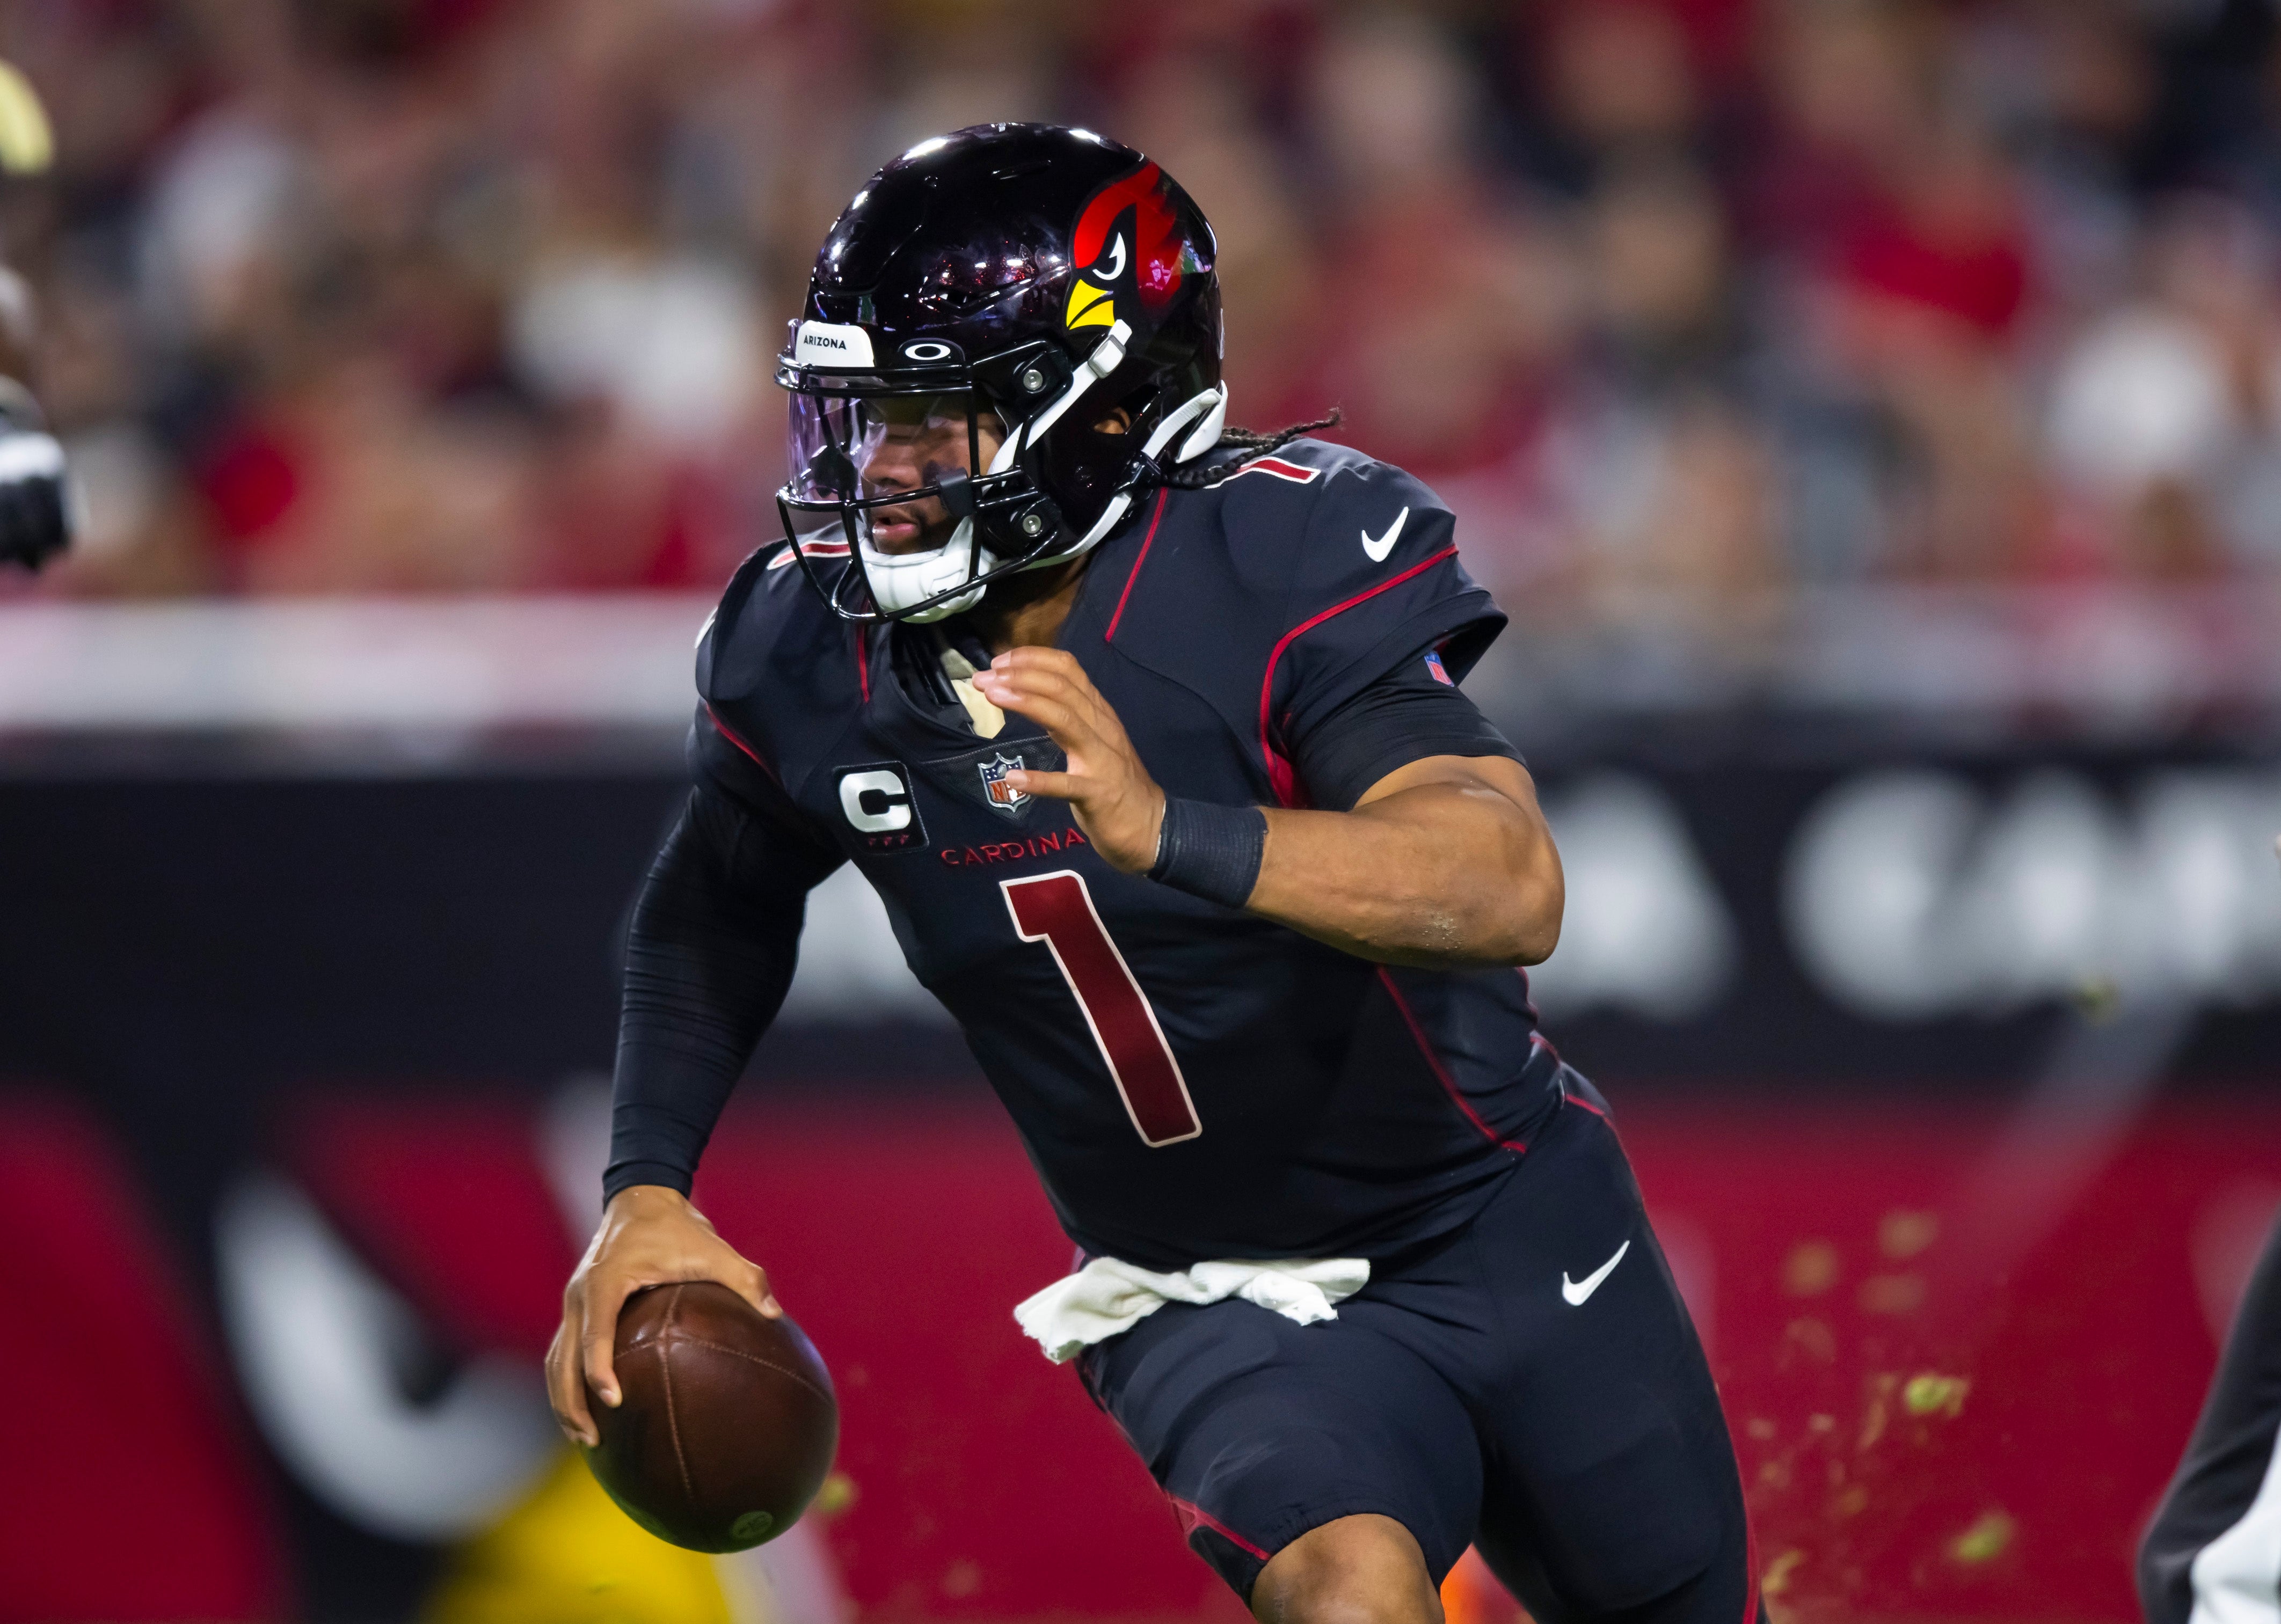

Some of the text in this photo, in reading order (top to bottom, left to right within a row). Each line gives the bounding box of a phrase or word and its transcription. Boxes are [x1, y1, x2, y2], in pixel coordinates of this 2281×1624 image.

[804, 335, 847, 350] ARIZONA
[840, 770, 911, 832] C
[941, 827, 1085, 865] CARDINA
[999, 869, 1203, 1148] 1
